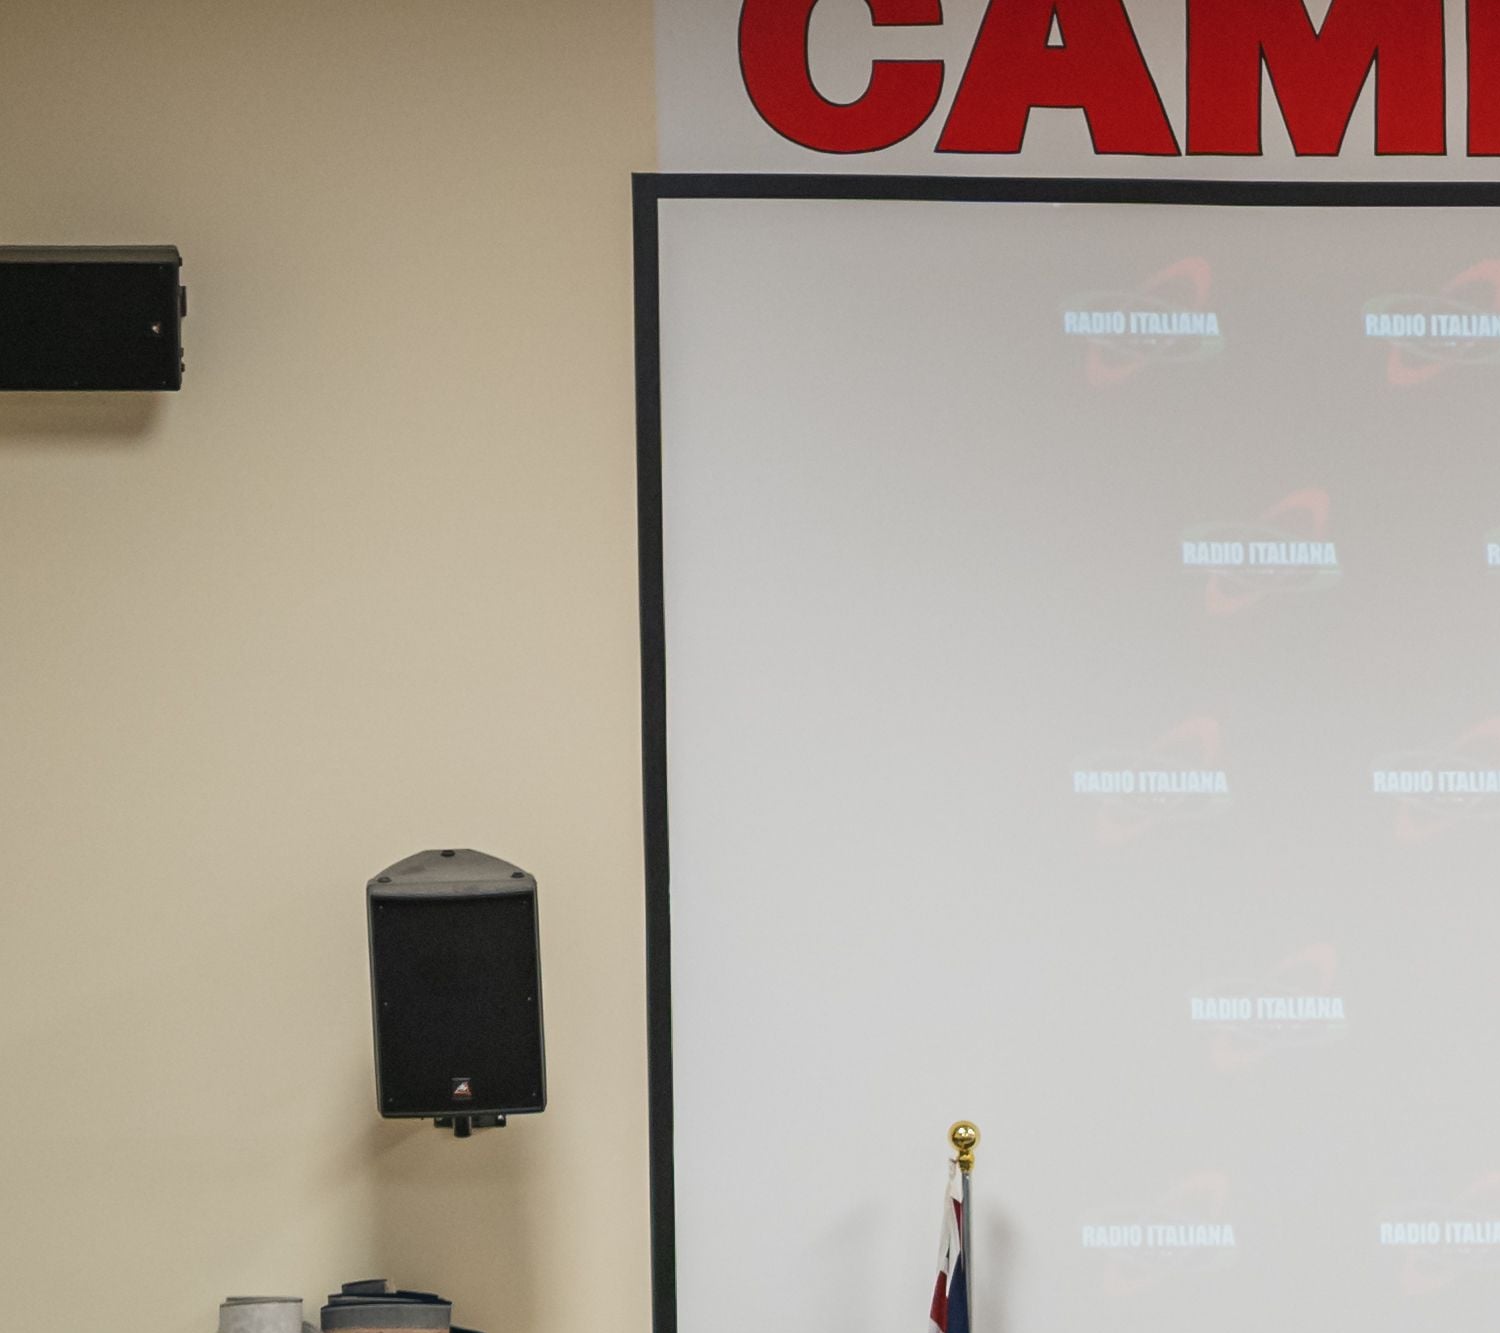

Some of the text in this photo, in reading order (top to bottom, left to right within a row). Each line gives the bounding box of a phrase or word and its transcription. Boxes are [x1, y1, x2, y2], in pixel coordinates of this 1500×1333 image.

[1063, 312, 1220, 337] RADIO ITALIANA
[1363, 314, 1424, 339] RADIO
[1181, 541, 1337, 567] RADIO ITALIANA
[1072, 770, 1228, 794] RADIO ITALIANA
[1372, 770, 1433, 794] RADIO
[1190, 996, 1345, 1021] RADIO ITALIANA
